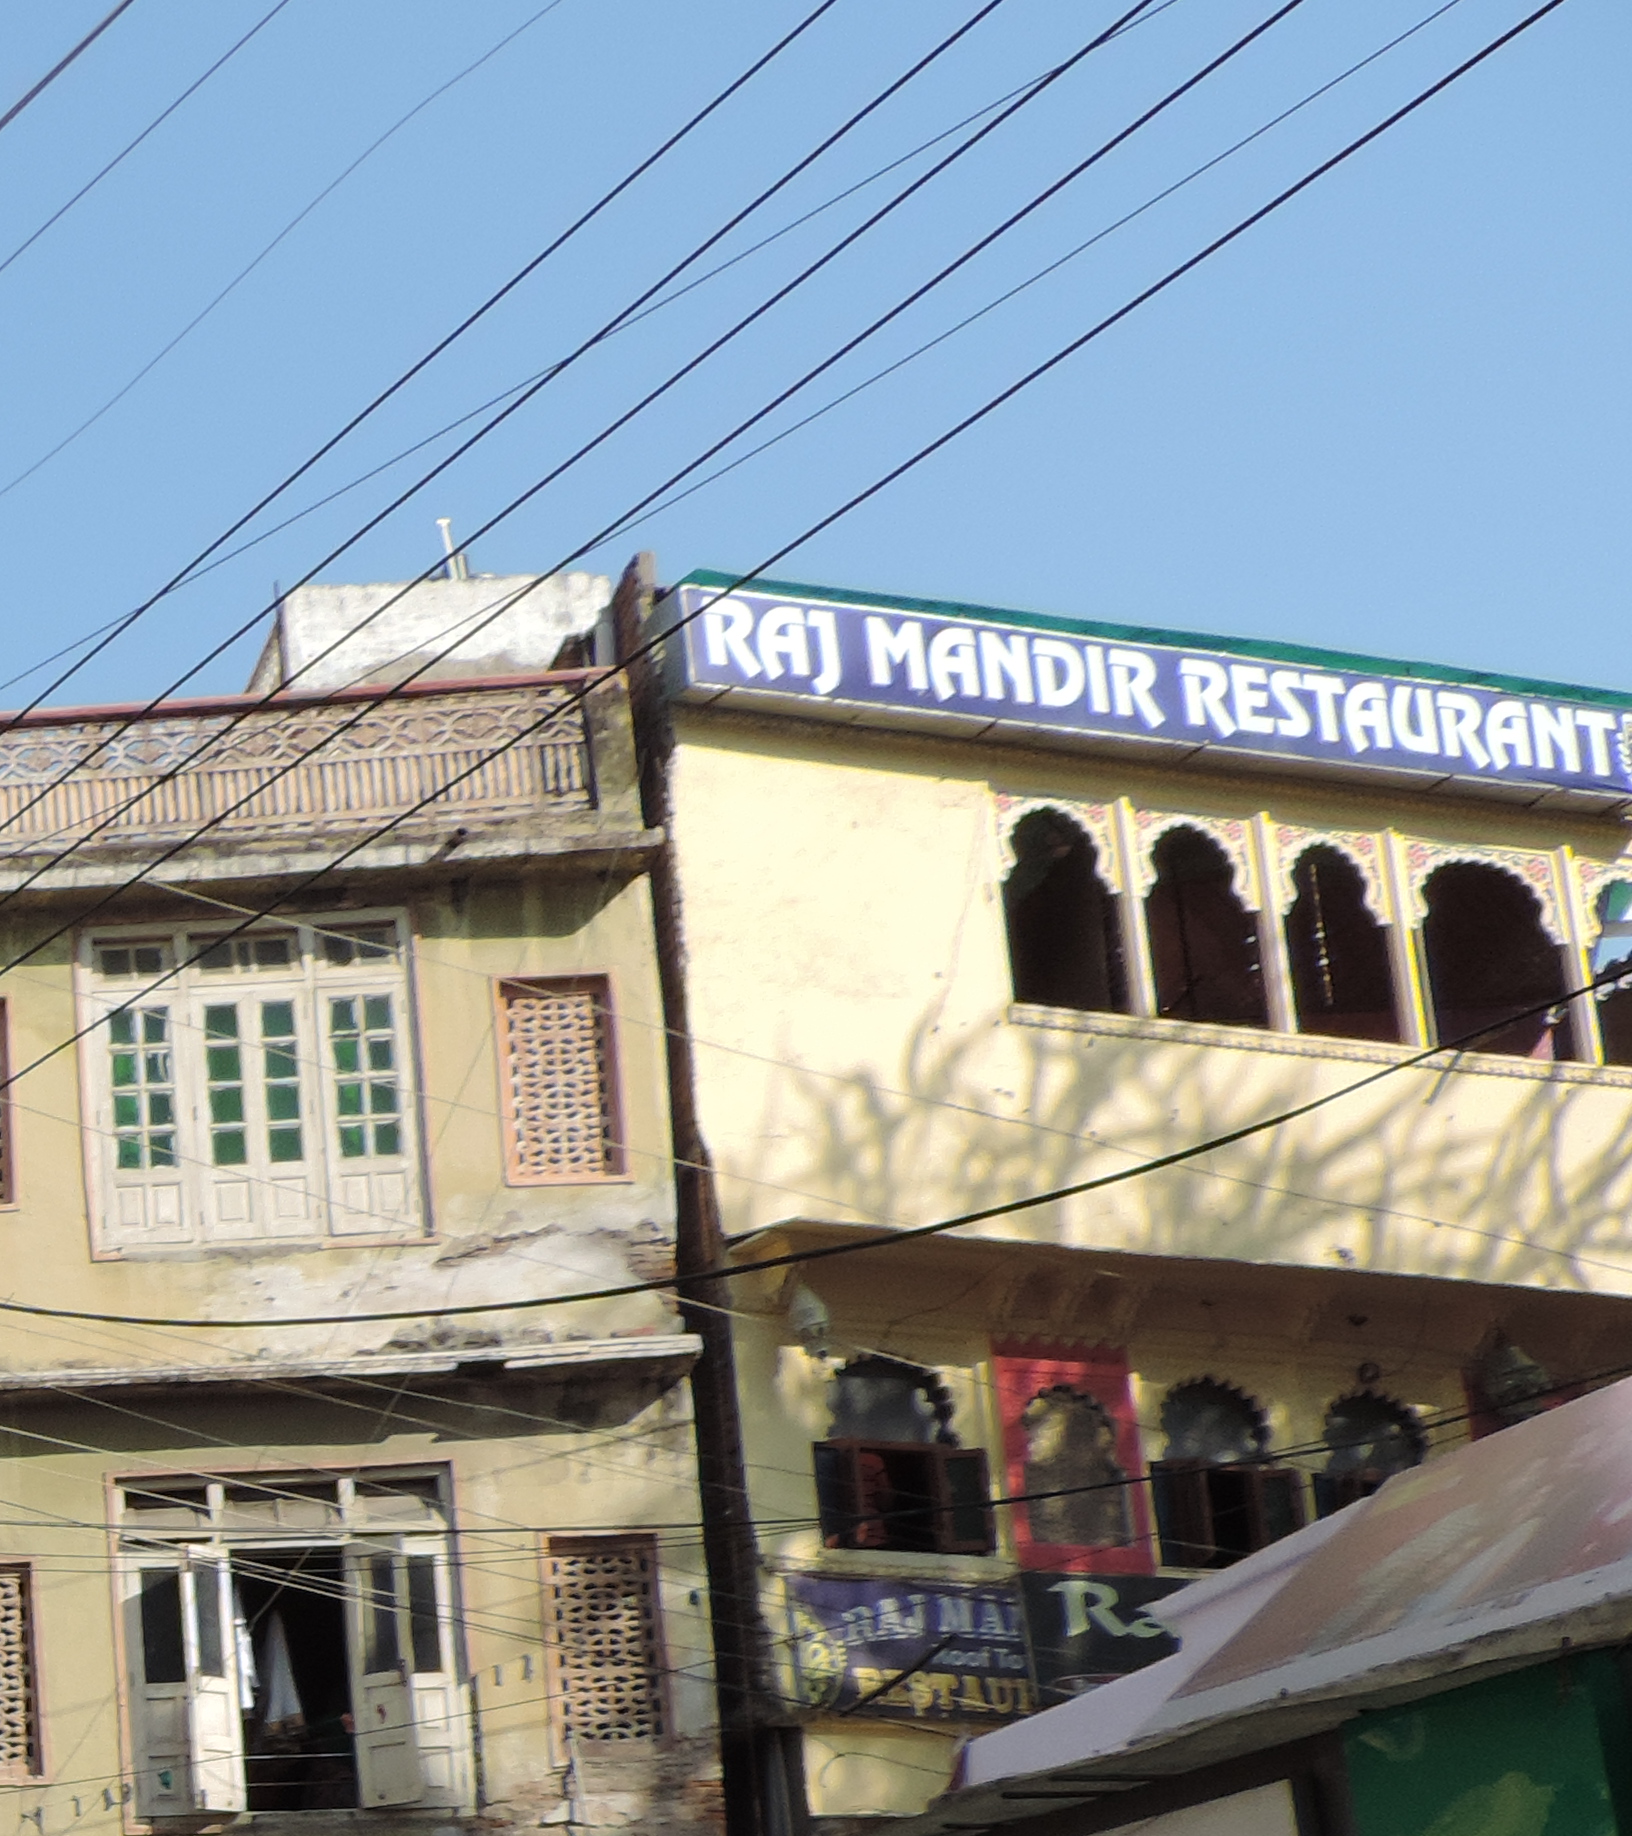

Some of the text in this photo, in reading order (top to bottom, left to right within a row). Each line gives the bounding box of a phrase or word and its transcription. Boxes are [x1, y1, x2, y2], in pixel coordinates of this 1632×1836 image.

[699, 595, 1617, 778] RAJ MANDIR RESTAURANT
